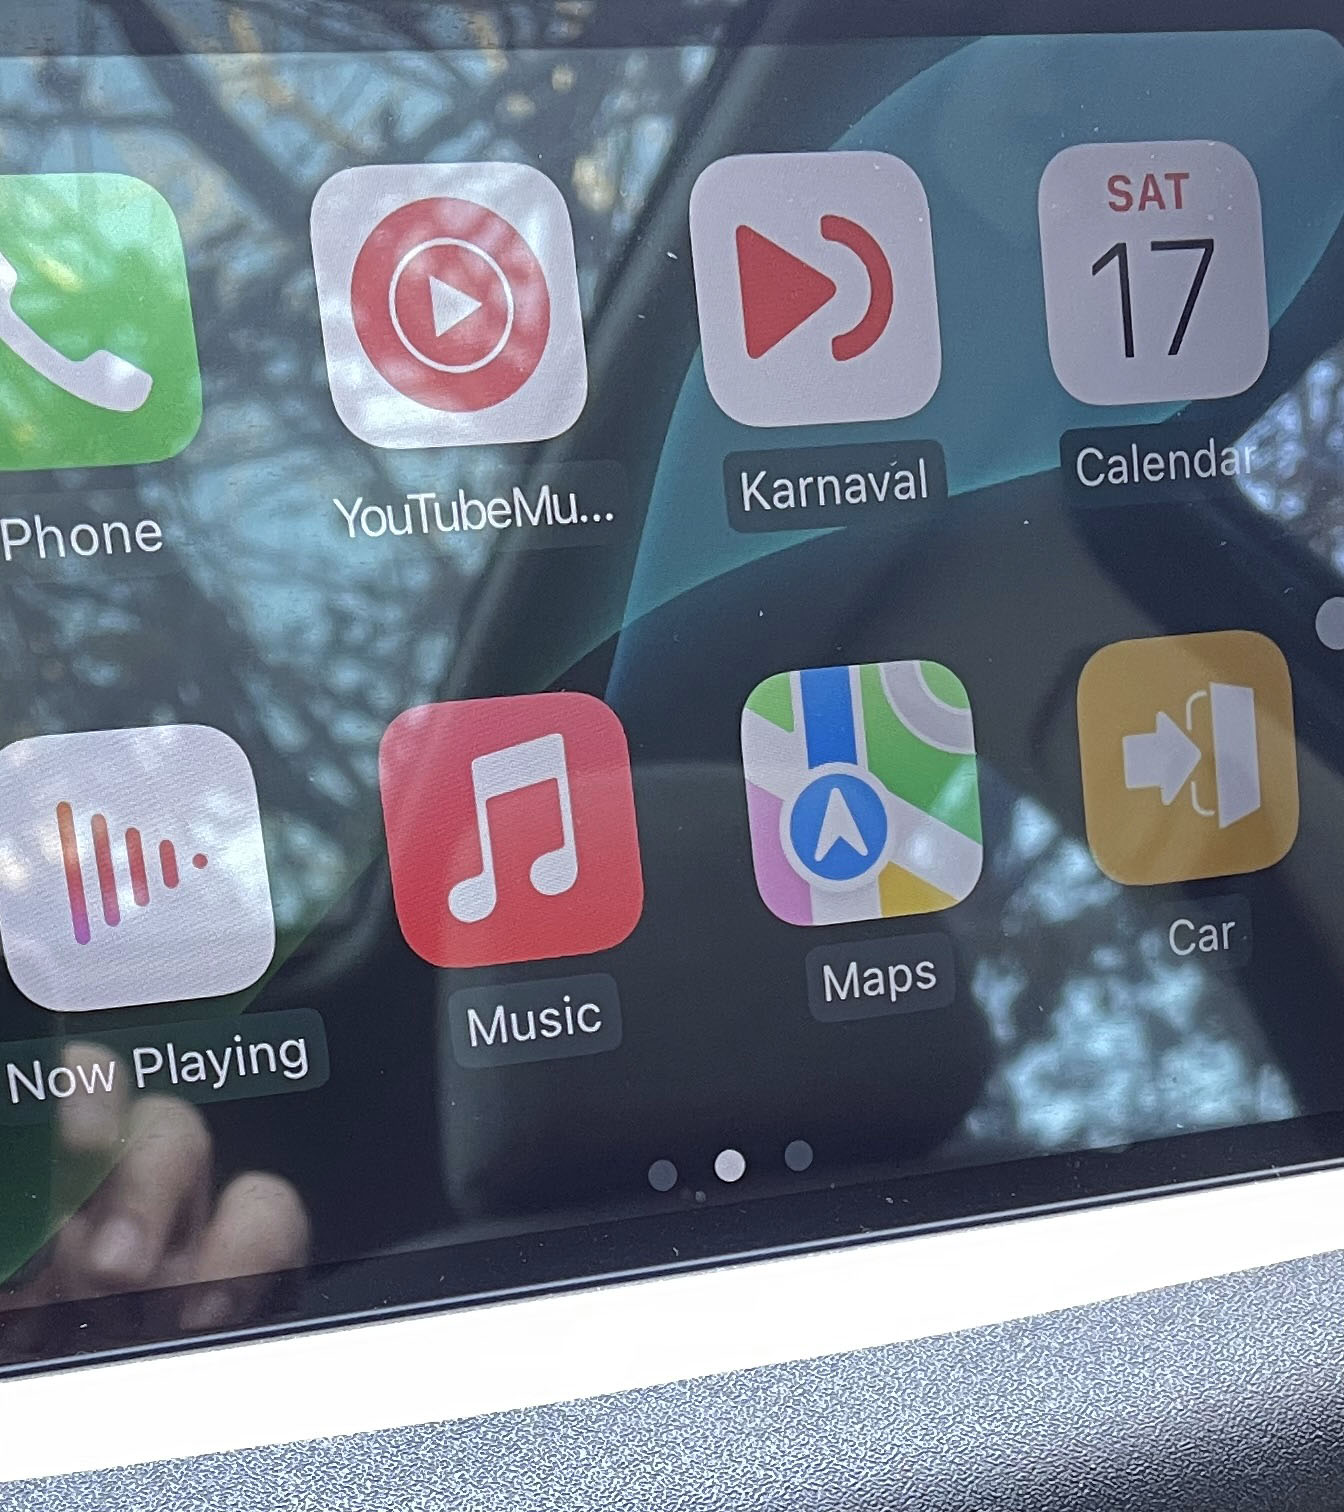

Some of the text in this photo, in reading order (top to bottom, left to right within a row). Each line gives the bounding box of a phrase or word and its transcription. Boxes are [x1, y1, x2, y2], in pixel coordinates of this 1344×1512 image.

[1107, 172, 1191, 212] SAT
[1091, 238, 1215, 359] 17
[740, 459, 929, 514] Karnaval
[1075, 437, 1259, 487] Calendar
[0, 514, 164, 561] Phone
[1168, 917, 1235, 957] Car
[822, 957, 938, 1005] Maps
[466, 995, 604, 1048] Music
[6, 1033, 310, 1104] Now Playing
